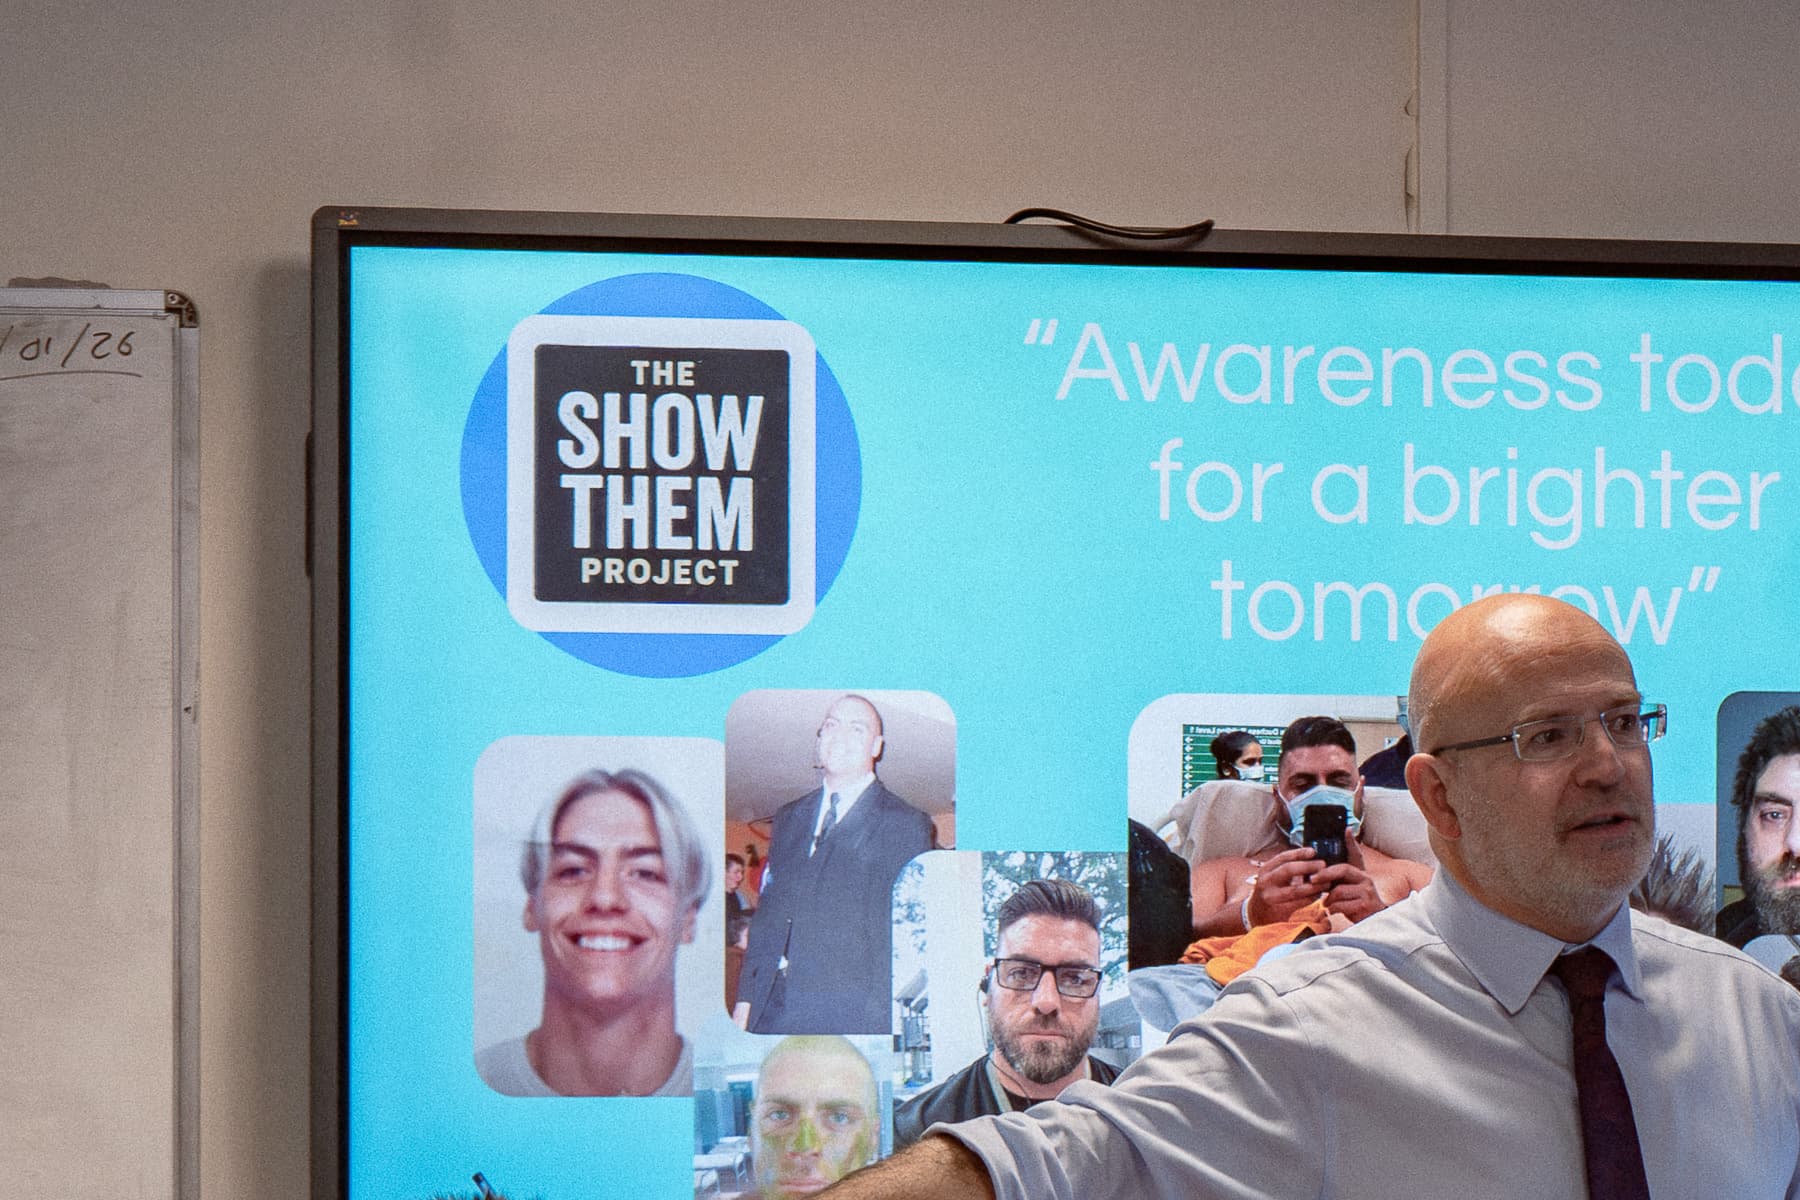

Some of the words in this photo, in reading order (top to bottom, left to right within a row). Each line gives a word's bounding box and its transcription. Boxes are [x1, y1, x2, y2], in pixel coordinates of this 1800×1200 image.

[630, 360, 696, 386] THE
[1023, 318, 1603, 411] “Awareness
[557, 390, 764, 472] SHOW
[560, 473, 754, 552] THEM
[1150, 438, 1284, 522] for
[1310, 463, 1368, 524] a
[1403, 443, 1780, 550] brighter
[581, 557, 739, 586] PROJECT
